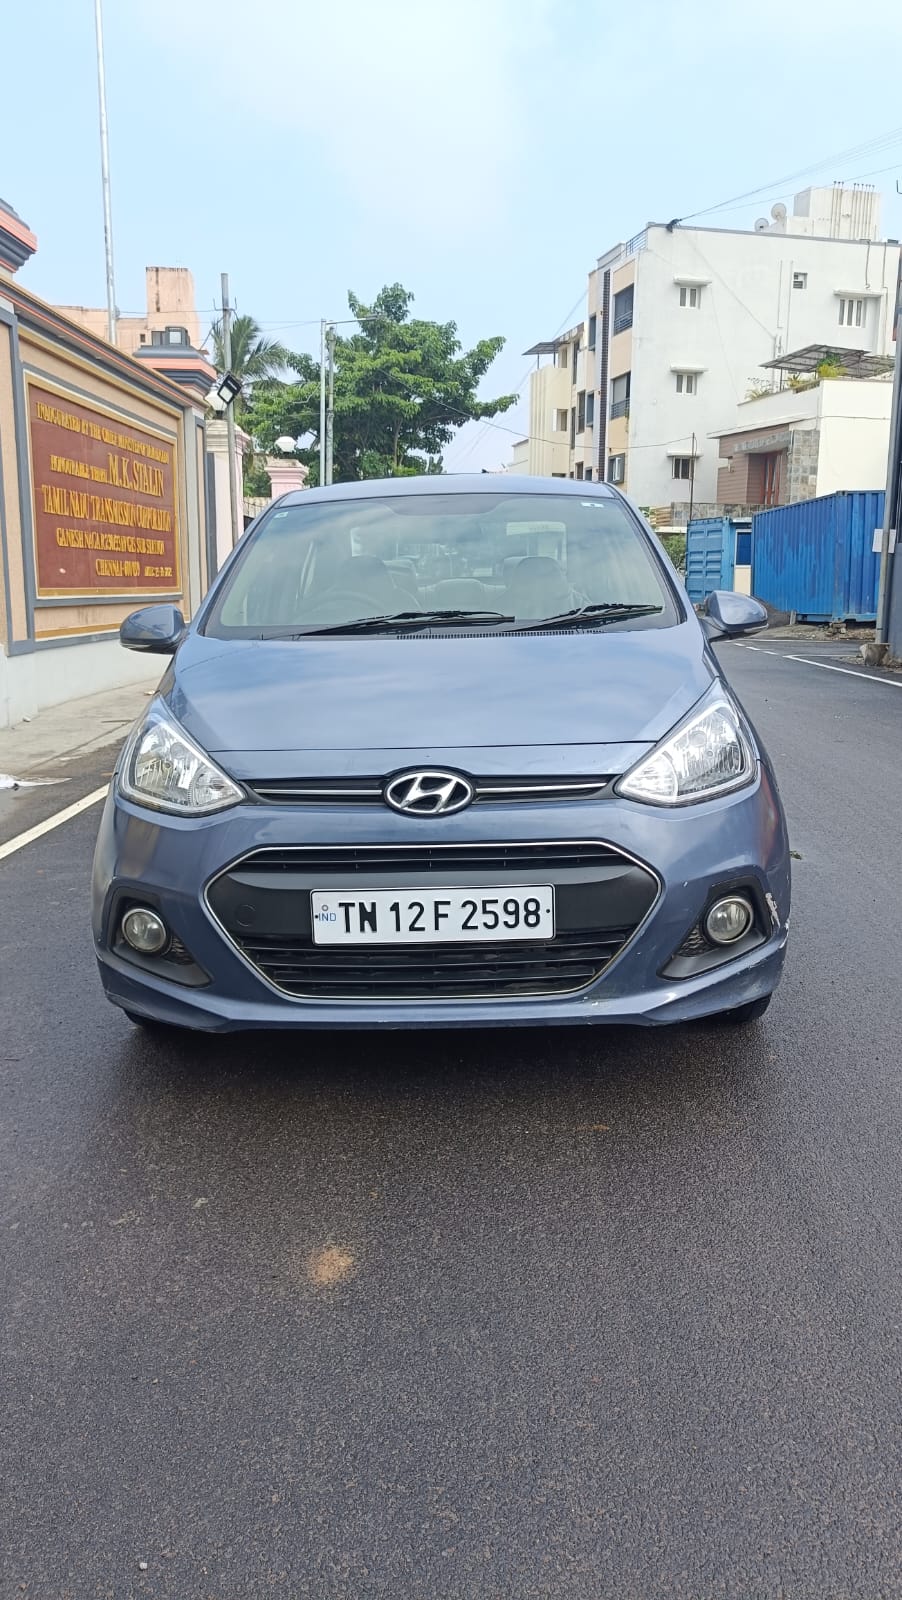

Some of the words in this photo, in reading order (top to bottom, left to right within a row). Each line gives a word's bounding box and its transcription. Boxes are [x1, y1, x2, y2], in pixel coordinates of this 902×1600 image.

[42, 485, 70, 516] TAMIL
[69, 490, 90, 519] NADU
[56, 527, 84, 548] GANESH
[318, 912, 337, 922] IND
[338, 901, 378, 933] TN
[389, 901, 426, 932] 12
[434, 900, 451, 931] F
[460, 898, 541, 930] 2598
